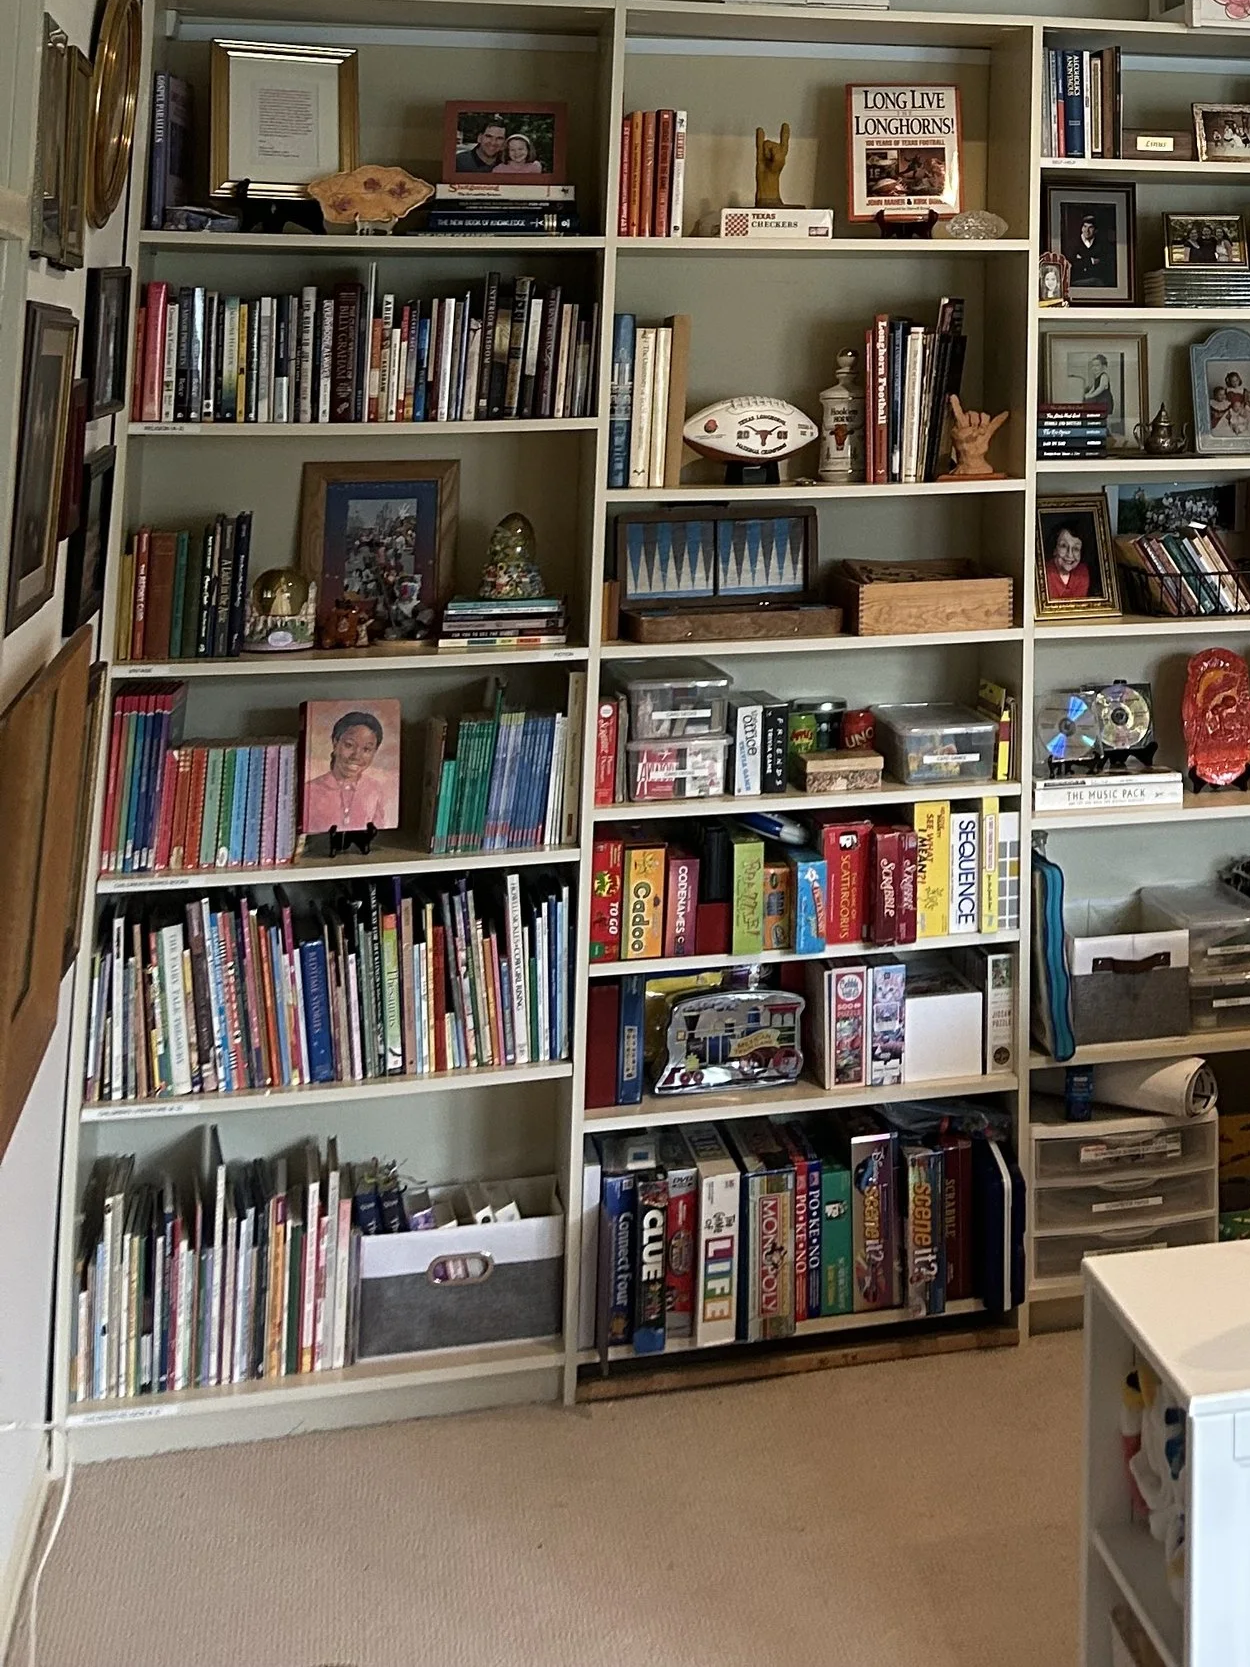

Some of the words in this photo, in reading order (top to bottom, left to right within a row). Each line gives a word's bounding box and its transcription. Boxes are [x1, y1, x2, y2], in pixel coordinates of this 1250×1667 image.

[156, 75, 166, 103] GOSPEL
[1073, 55, 1081, 96] ALCOHOLICS
[863, 90, 908, 109] LONG
[910, 90, 945, 109] LIVE
[155, 103, 165, 143] PARALLELS
[855, 116, 955, 135] LONGHORNS!
[338, 304, 349, 334] BILLY
[486, 285, 496, 327] INTERIOR
[302, 338, 311, 347] TO
[336, 334, 347, 379] GRAHAM
[483, 328, 493, 364] WISDOM
[876, 320, 887, 374] Longhorn
[877, 377, 886, 424] Football
[736, 430, 750, 439] 20
[738, 416, 755, 426] TEXAS
[137, 575, 146, 602] REPORT
[220, 567, 232, 585] Light
[221, 585, 230, 594] in
[218, 606, 229, 623] Attic
[220, 594, 231, 606] the
[742, 714, 758, 755] office
[766, 727, 774, 752] TRIVIA
[845, 726, 874, 749] UNO
[738, 740, 747, 767] TRIVIA
[741, 768, 751, 791] GAME
[1066, 791, 1083, 801] THE
[1088, 789, 1117, 800] MUSIC
[1122, 788, 1146, 798] PACK
[926, 813, 934, 831] SEE
[918, 836, 927, 884] MEAN?!
[926, 833, 934, 863] WHAT
[958, 820, 976, 924] SEQUENCE
[675, 865, 689, 934] CODENAMES
[839, 854, 851, 939] SCATTERGORIES
[880, 858, 896, 917] SCRABBLE
[609, 901, 619, 916] TO
[631, 881, 652, 952] Cadoo
[608, 917, 619, 935] GO
[168, 933, 177, 955] THE
[169, 957, 179, 986] FAIRY
[307, 951, 320, 994] BEDTIME
[514, 947, 522, 983] COWGIRL
[172, 989, 182, 1013] TALE
[386, 969, 402, 1028] Thesaurus
[516, 985, 524, 1011] RISING
[311, 995, 323, 1034] STORIES
[992, 1018, 1012, 1027] PUZZLE
[174, 1017, 185, 1066] TREASURY
[862, 1186, 882, 1240] scene
[912, 1182, 933, 1247] scene
[944, 1178, 956, 1238] SCRABBLE
[617, 1211, 634, 1271] Connect
[641, 1209, 664, 1282] CLUE
[761, 1199, 778, 1313] MONOPOLY
[865, 1239, 884, 1262] it?
[913, 1247, 938, 1275] it?
[615, 1272, 631, 1306] Four
[704, 1239, 733, 1321] LIFE
